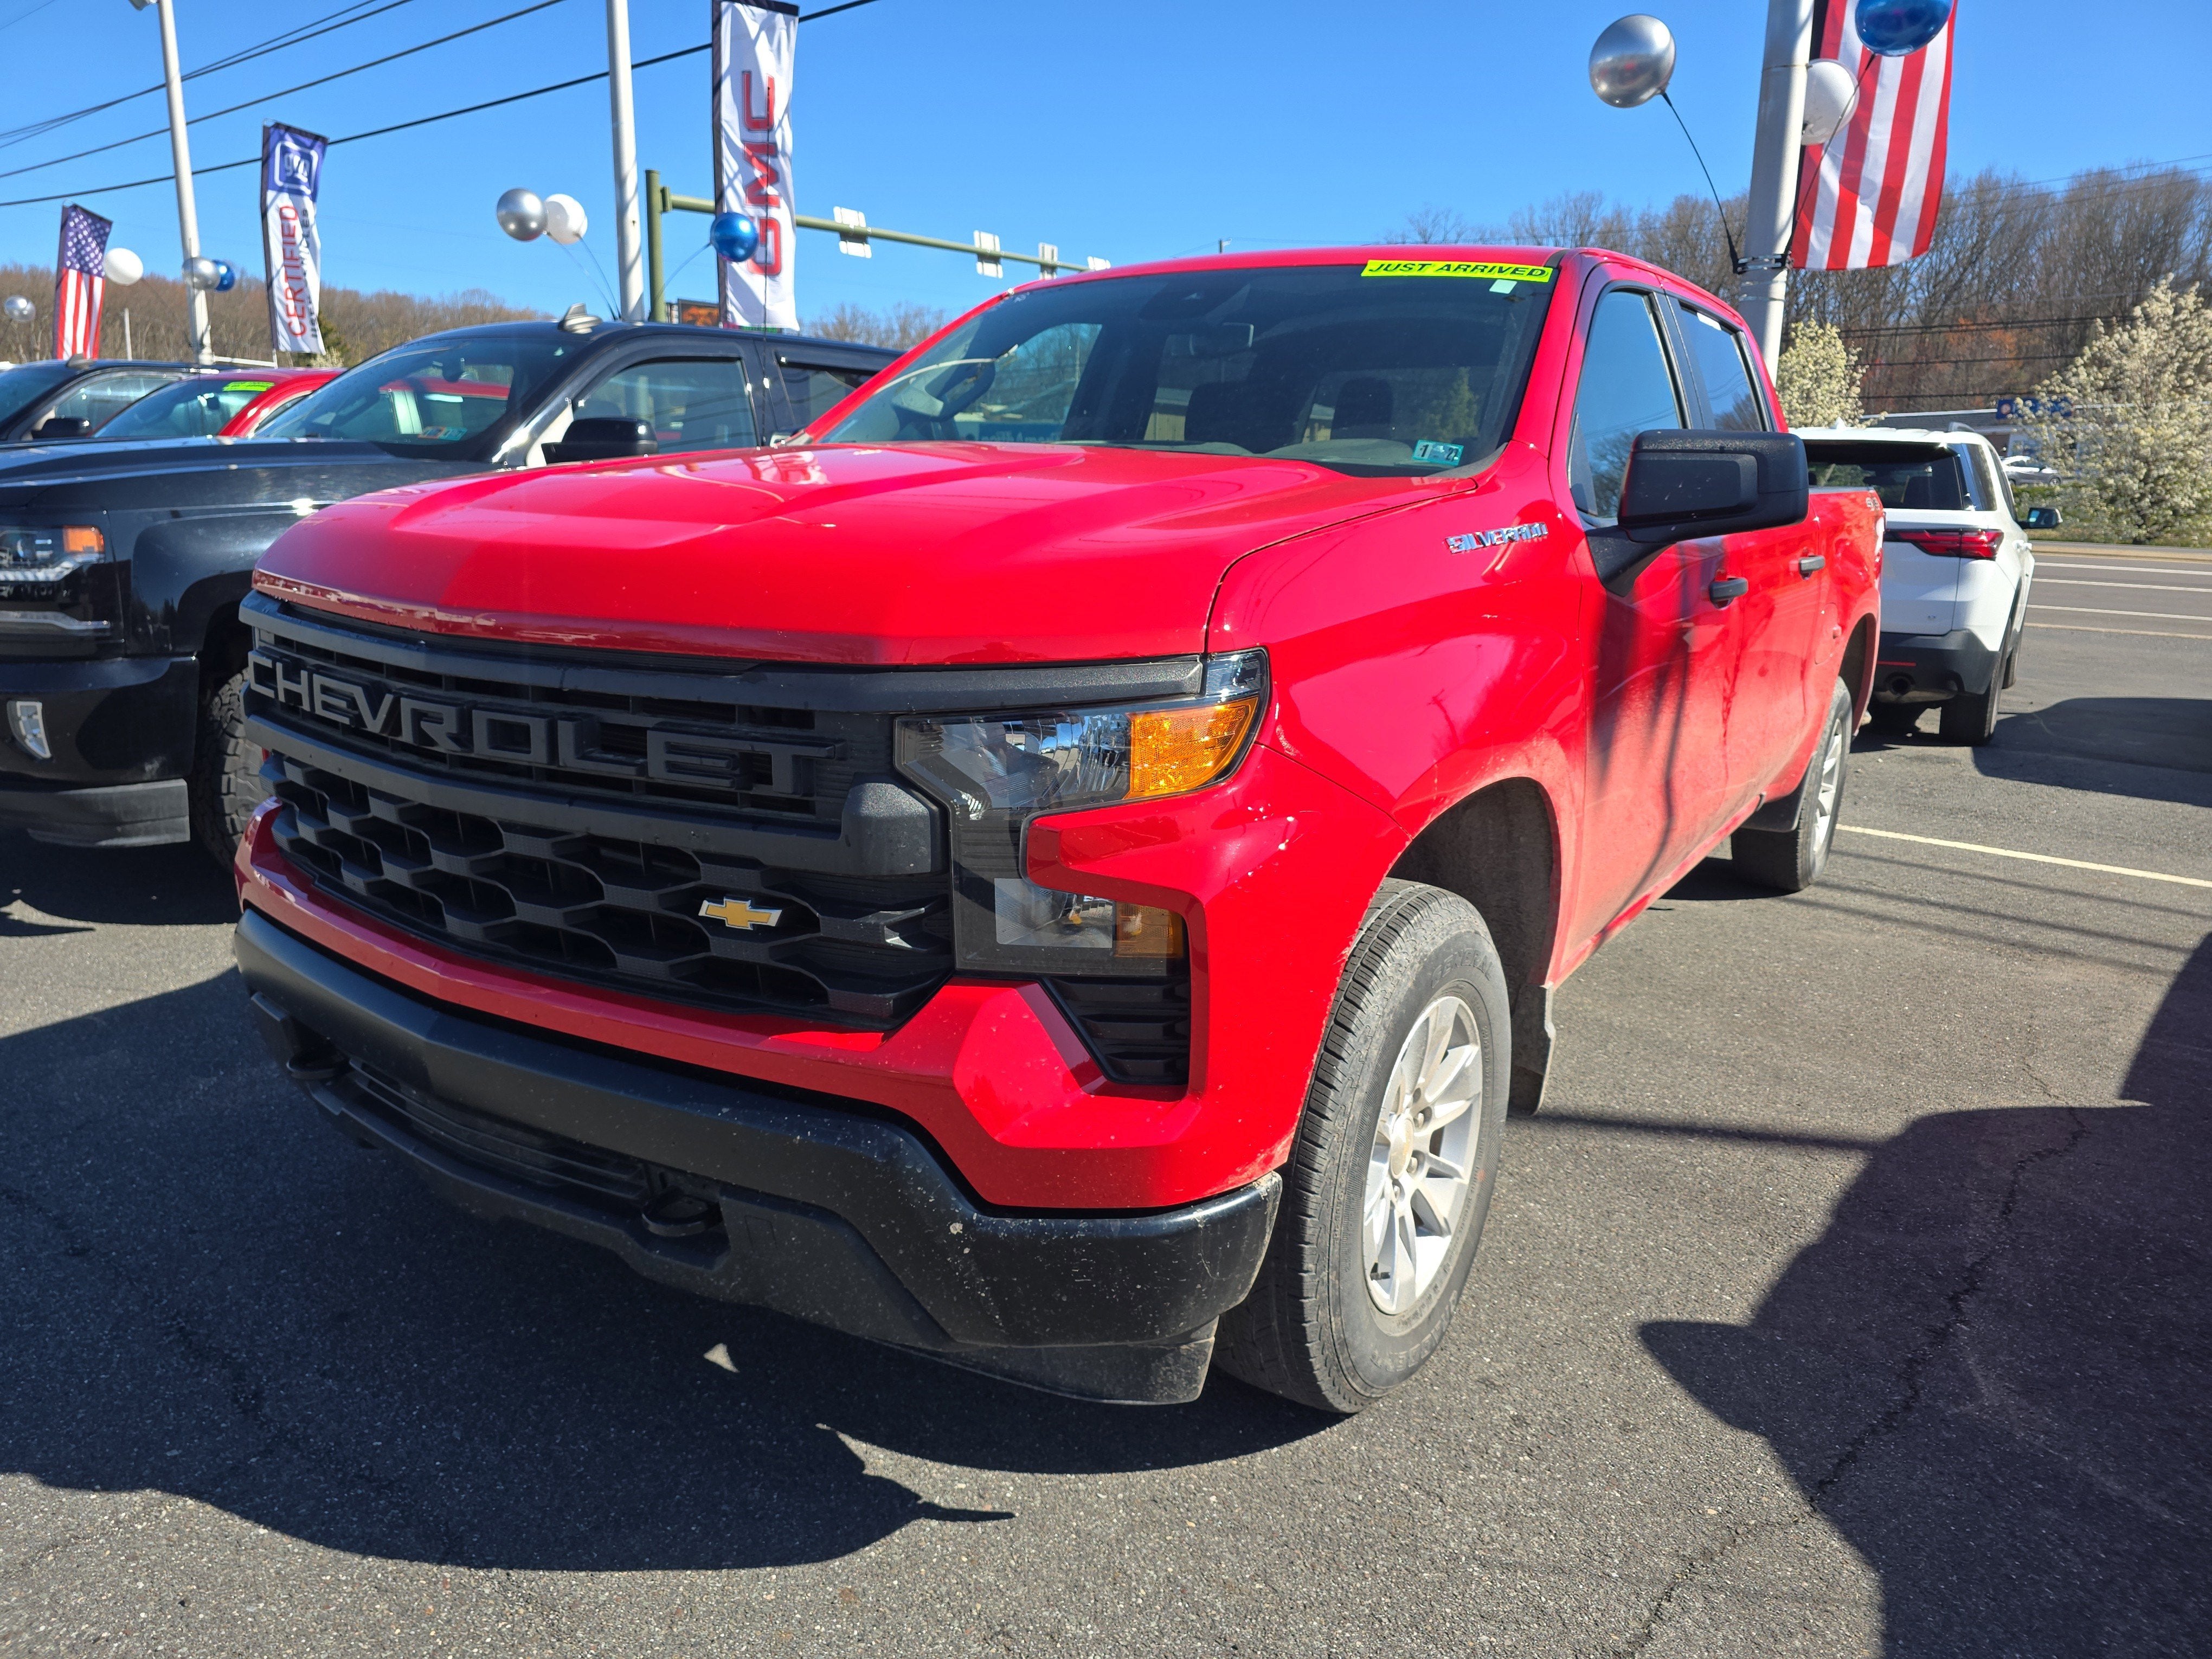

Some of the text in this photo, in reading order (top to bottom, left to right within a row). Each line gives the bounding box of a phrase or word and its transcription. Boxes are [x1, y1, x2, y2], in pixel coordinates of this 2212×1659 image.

[742, 70, 781, 275] GMC
[280, 204, 307, 337] CERTIFIED
[1369, 263, 1547, 277] JUST ARRIVED
[248, 651, 844, 796] CHEVROLET
